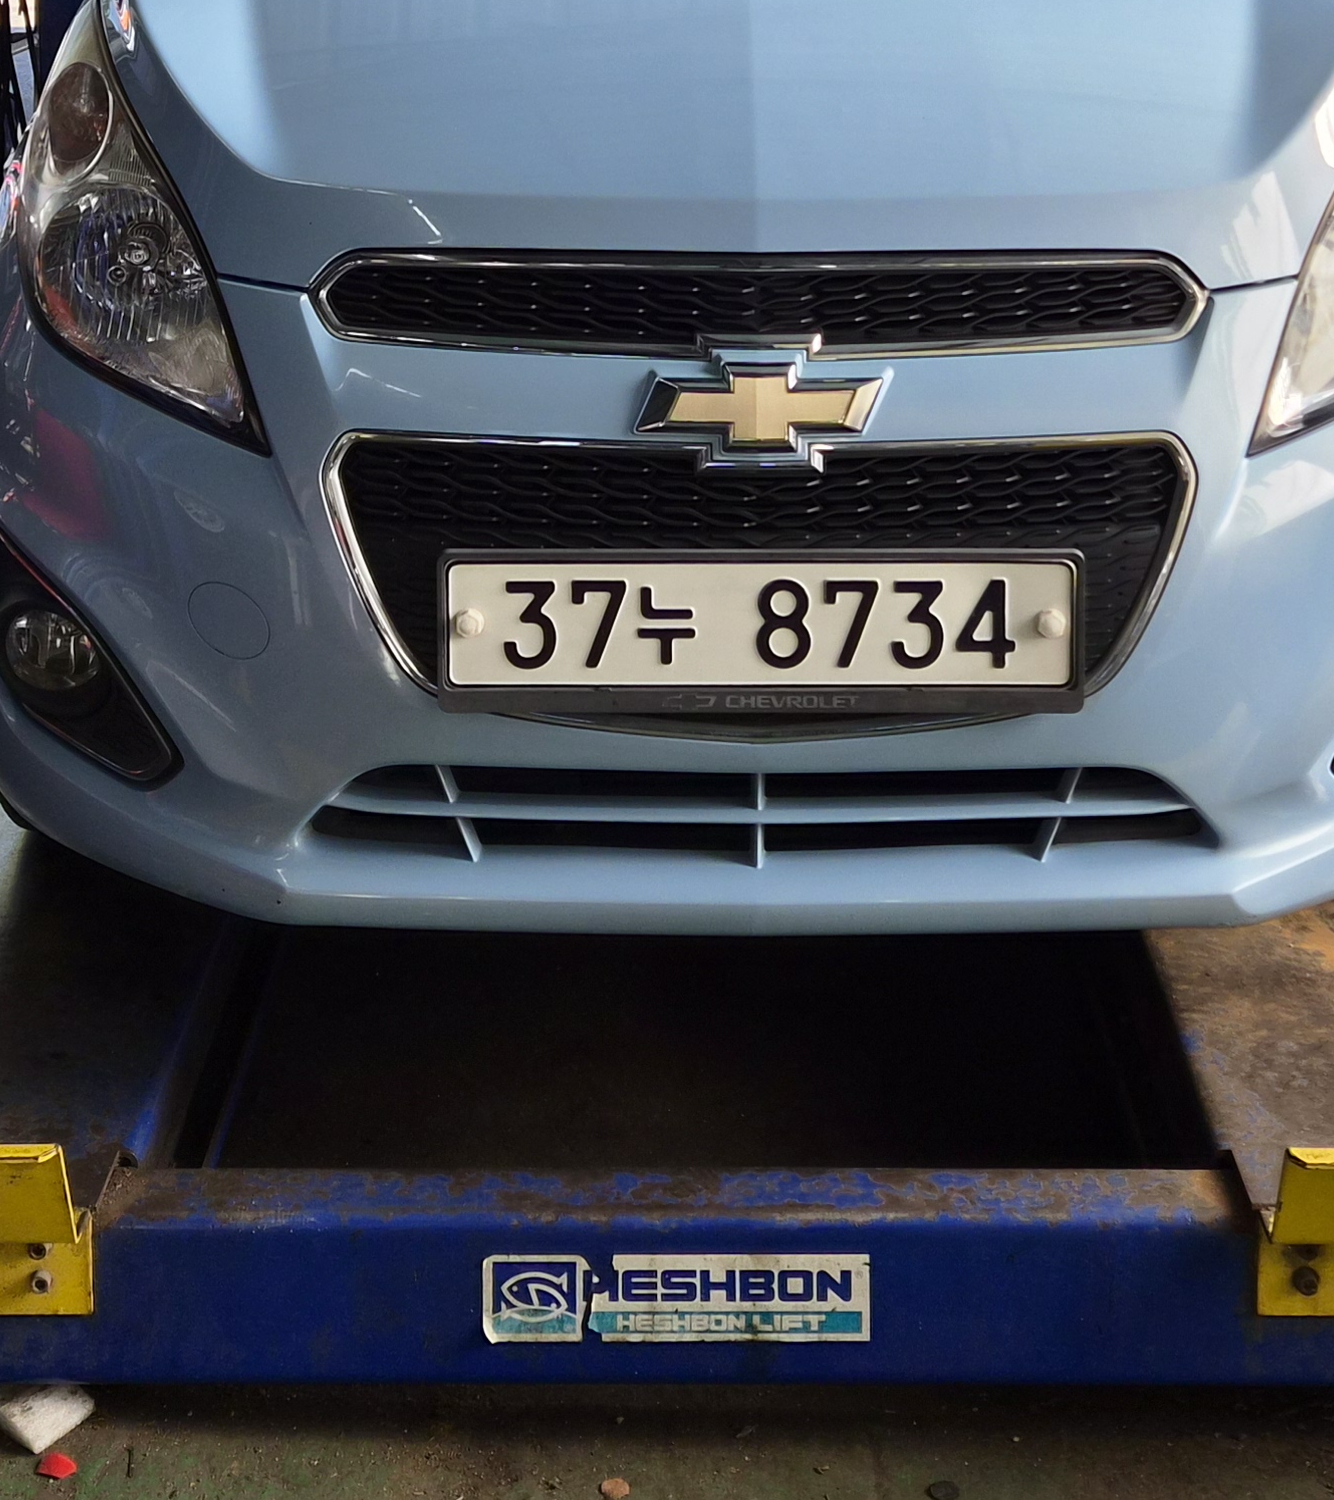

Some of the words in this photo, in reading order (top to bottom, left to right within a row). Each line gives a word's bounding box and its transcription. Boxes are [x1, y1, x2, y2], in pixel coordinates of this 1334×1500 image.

[502, 579, 696, 670] 37누
[755, 579, 1016, 670] 8734
[724, 694, 860, 709] CHEVROLET
[616, 1313, 746, 1332] HESHBON
[756, 1313, 827, 1332] LIFT
